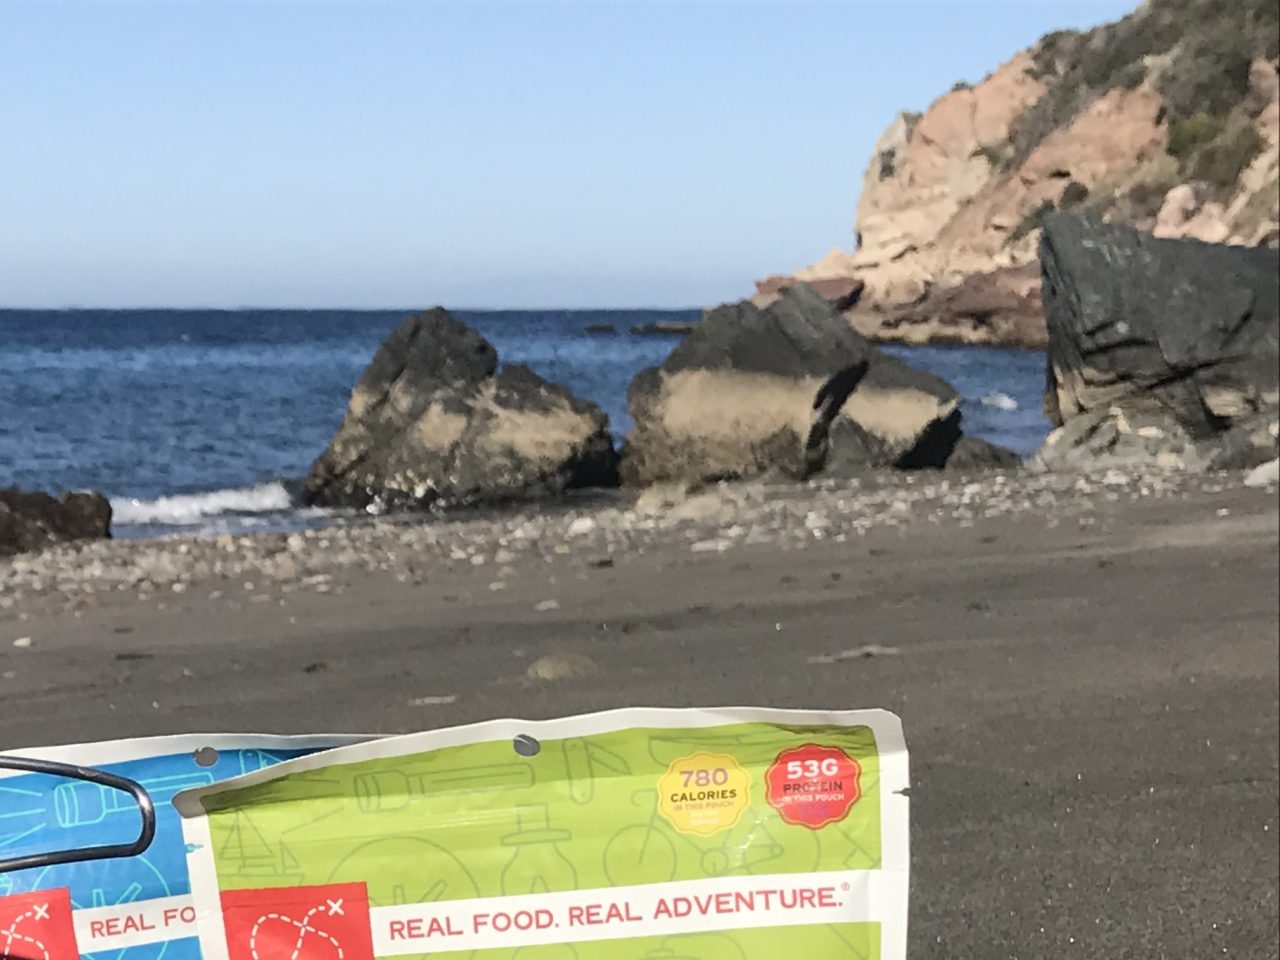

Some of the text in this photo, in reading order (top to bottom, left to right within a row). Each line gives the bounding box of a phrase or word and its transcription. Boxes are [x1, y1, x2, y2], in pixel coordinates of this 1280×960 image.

[680, 767, 729, 788] 780
[787, 757, 839, 779] 53G
[670, 789, 737, 803] CALORIES
[782, 780, 843, 793] PROTEIN
[90, 913, 155, 939] REAL
[389, 916, 463, 940] REAL
[473, 909, 559, 934] FOOD.
[569, 901, 642, 927] REAL
